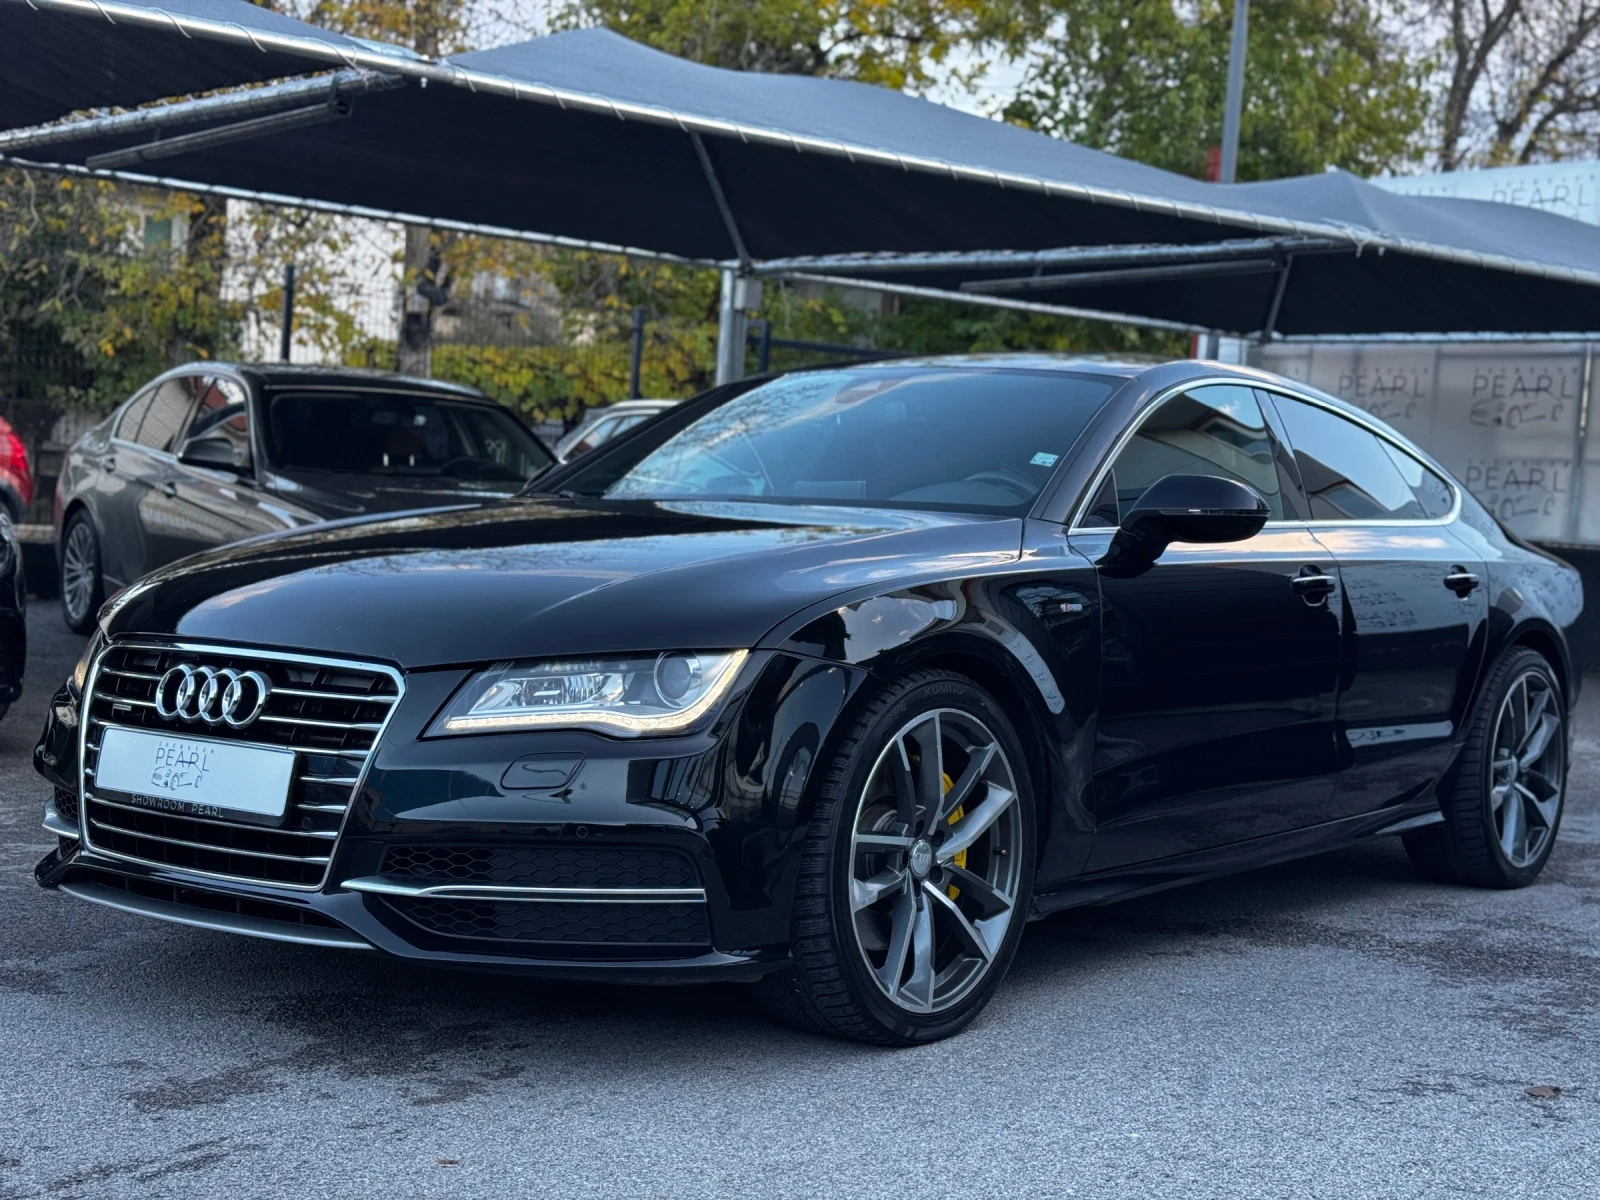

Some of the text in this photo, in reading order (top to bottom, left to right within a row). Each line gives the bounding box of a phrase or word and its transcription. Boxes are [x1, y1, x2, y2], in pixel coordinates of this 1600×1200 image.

[1337, 374, 1426, 398] PEARL
[1471, 373, 1574, 399] PEARL
[1465, 465, 1567, 493] PEARL
[155, 747, 210, 772] PEARL
[131, 794, 224, 818] SHOWROOM PEARL
